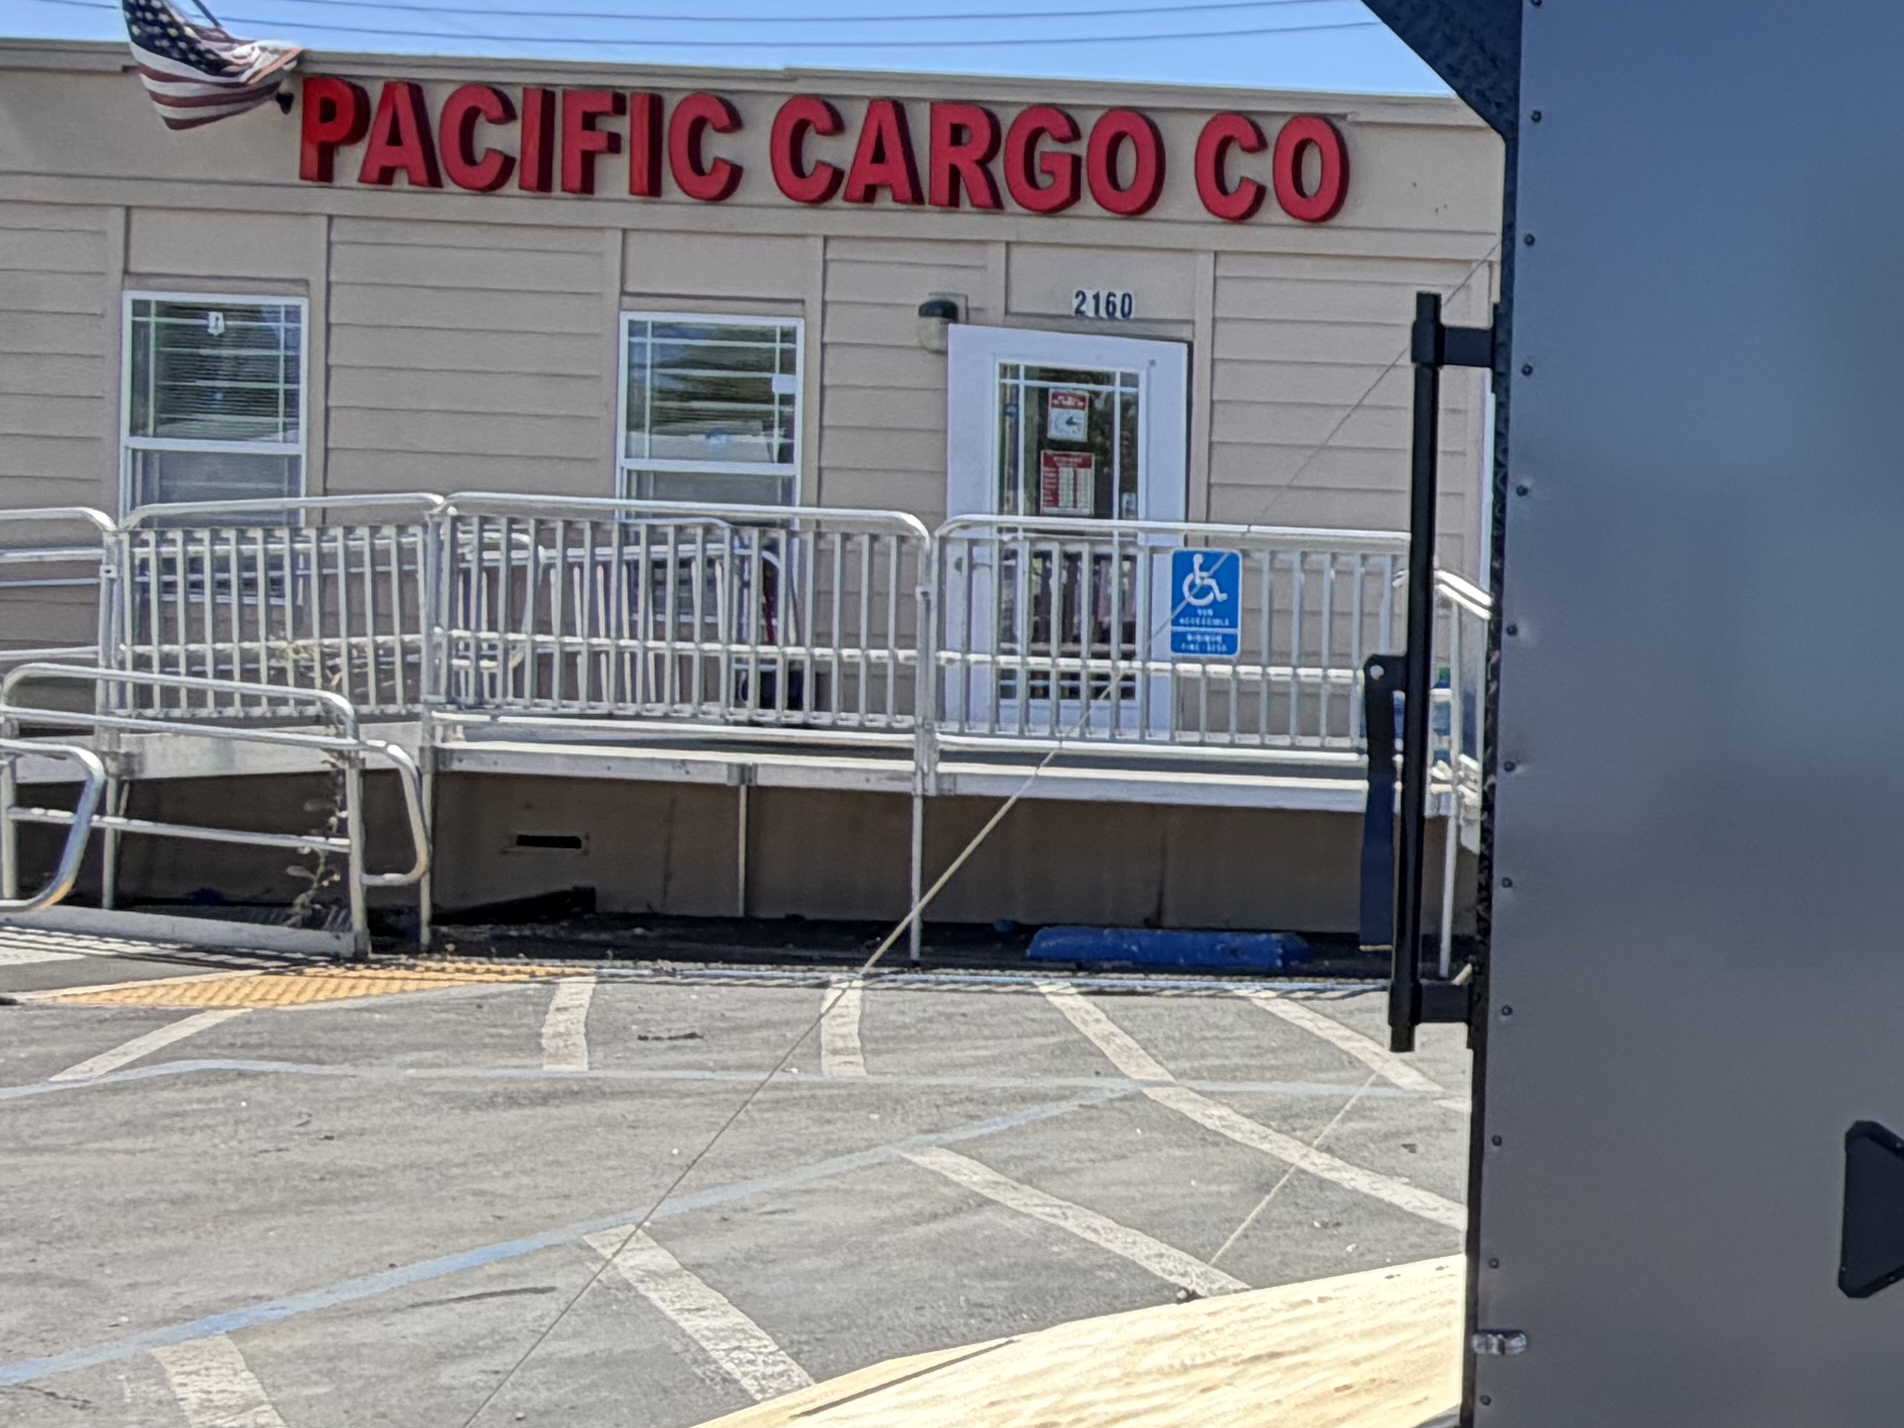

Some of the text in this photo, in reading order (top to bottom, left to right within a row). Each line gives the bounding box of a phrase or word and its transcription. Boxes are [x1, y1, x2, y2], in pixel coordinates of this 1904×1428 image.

[299, 75, 1351, 224] PACIFIC CARGO CO
[1074, 289, 1133, 319] 2160
